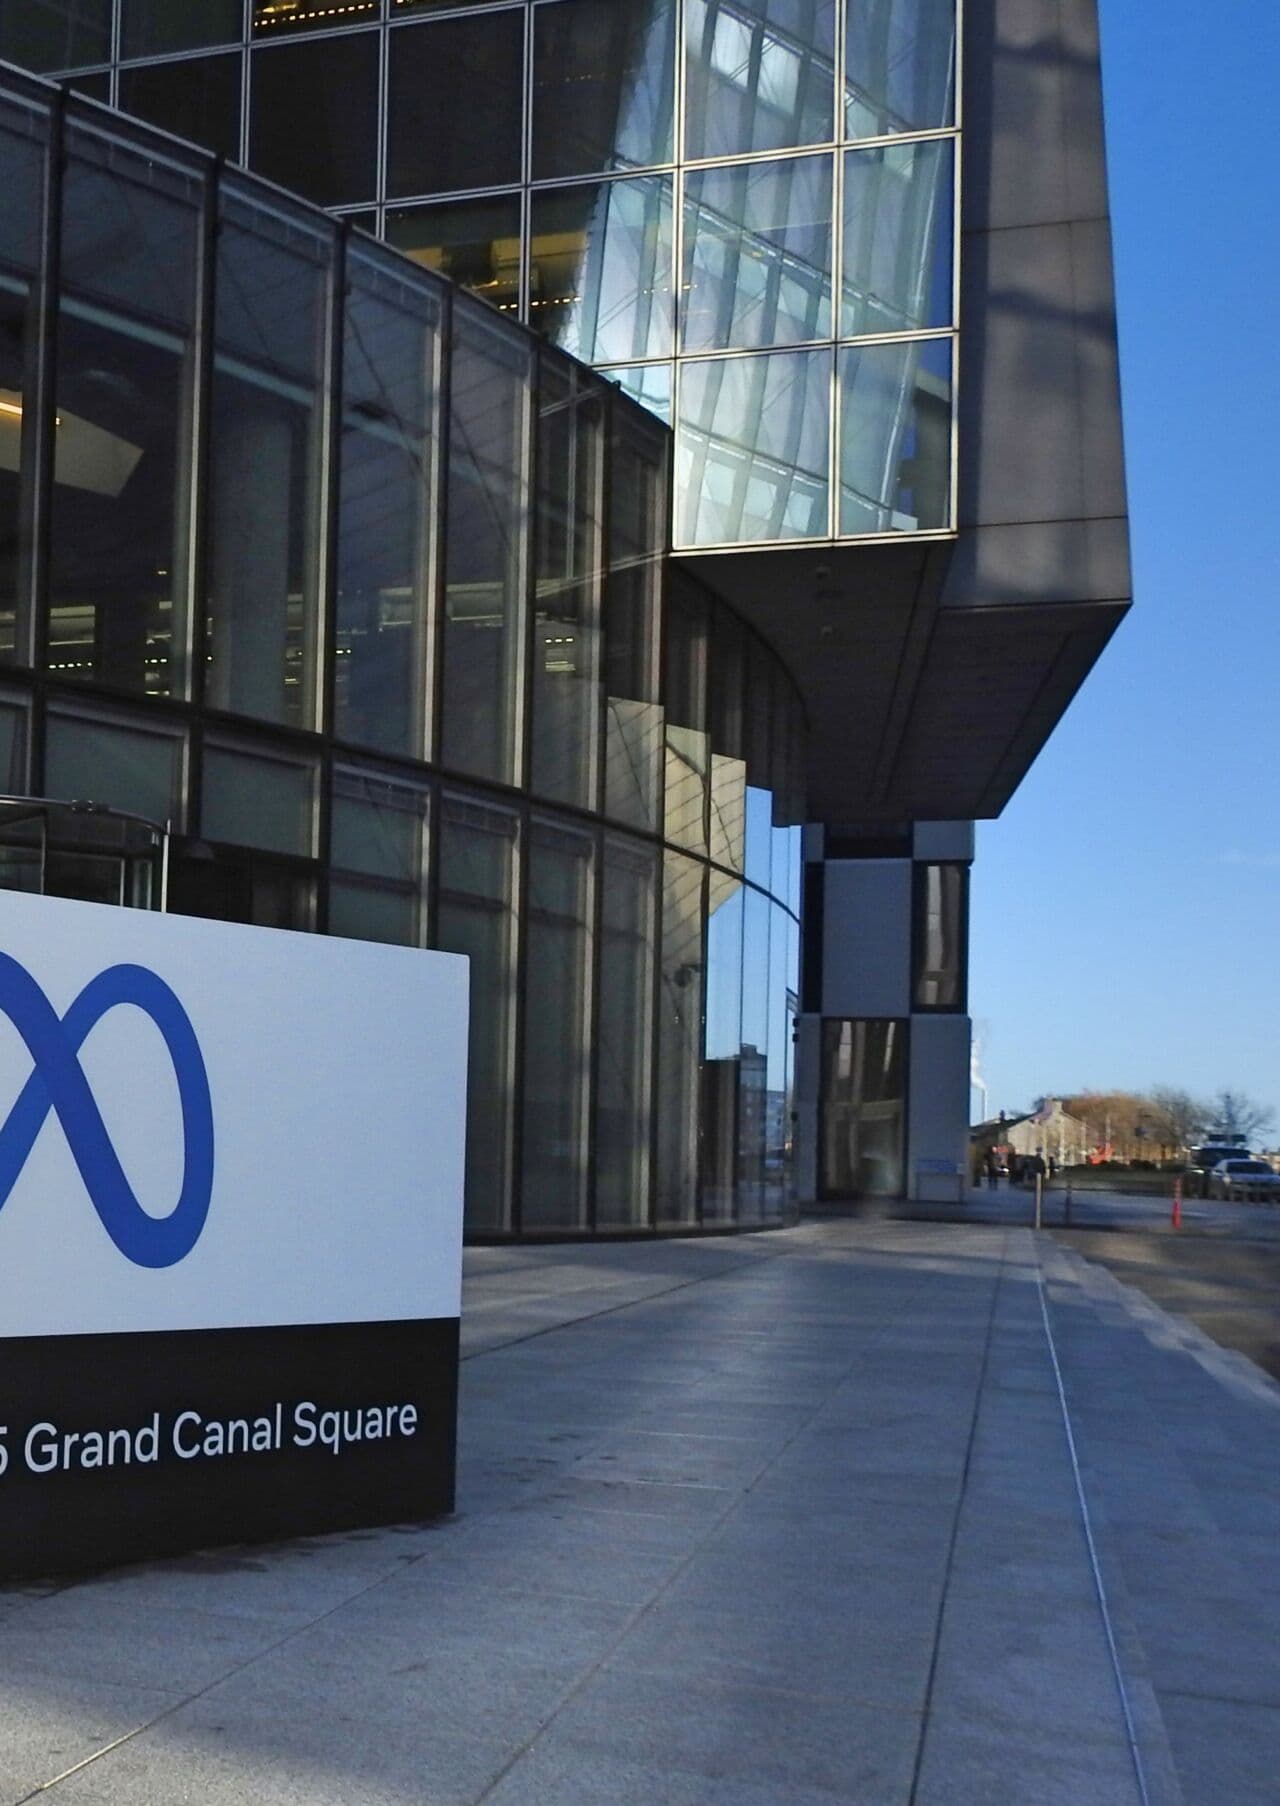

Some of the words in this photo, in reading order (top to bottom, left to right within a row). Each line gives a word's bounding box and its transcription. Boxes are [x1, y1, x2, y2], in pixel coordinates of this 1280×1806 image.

[24, 1412, 160, 1473] Grand
[172, 1403, 282, 1459] Canal
[293, 1401, 419, 1455] Square
